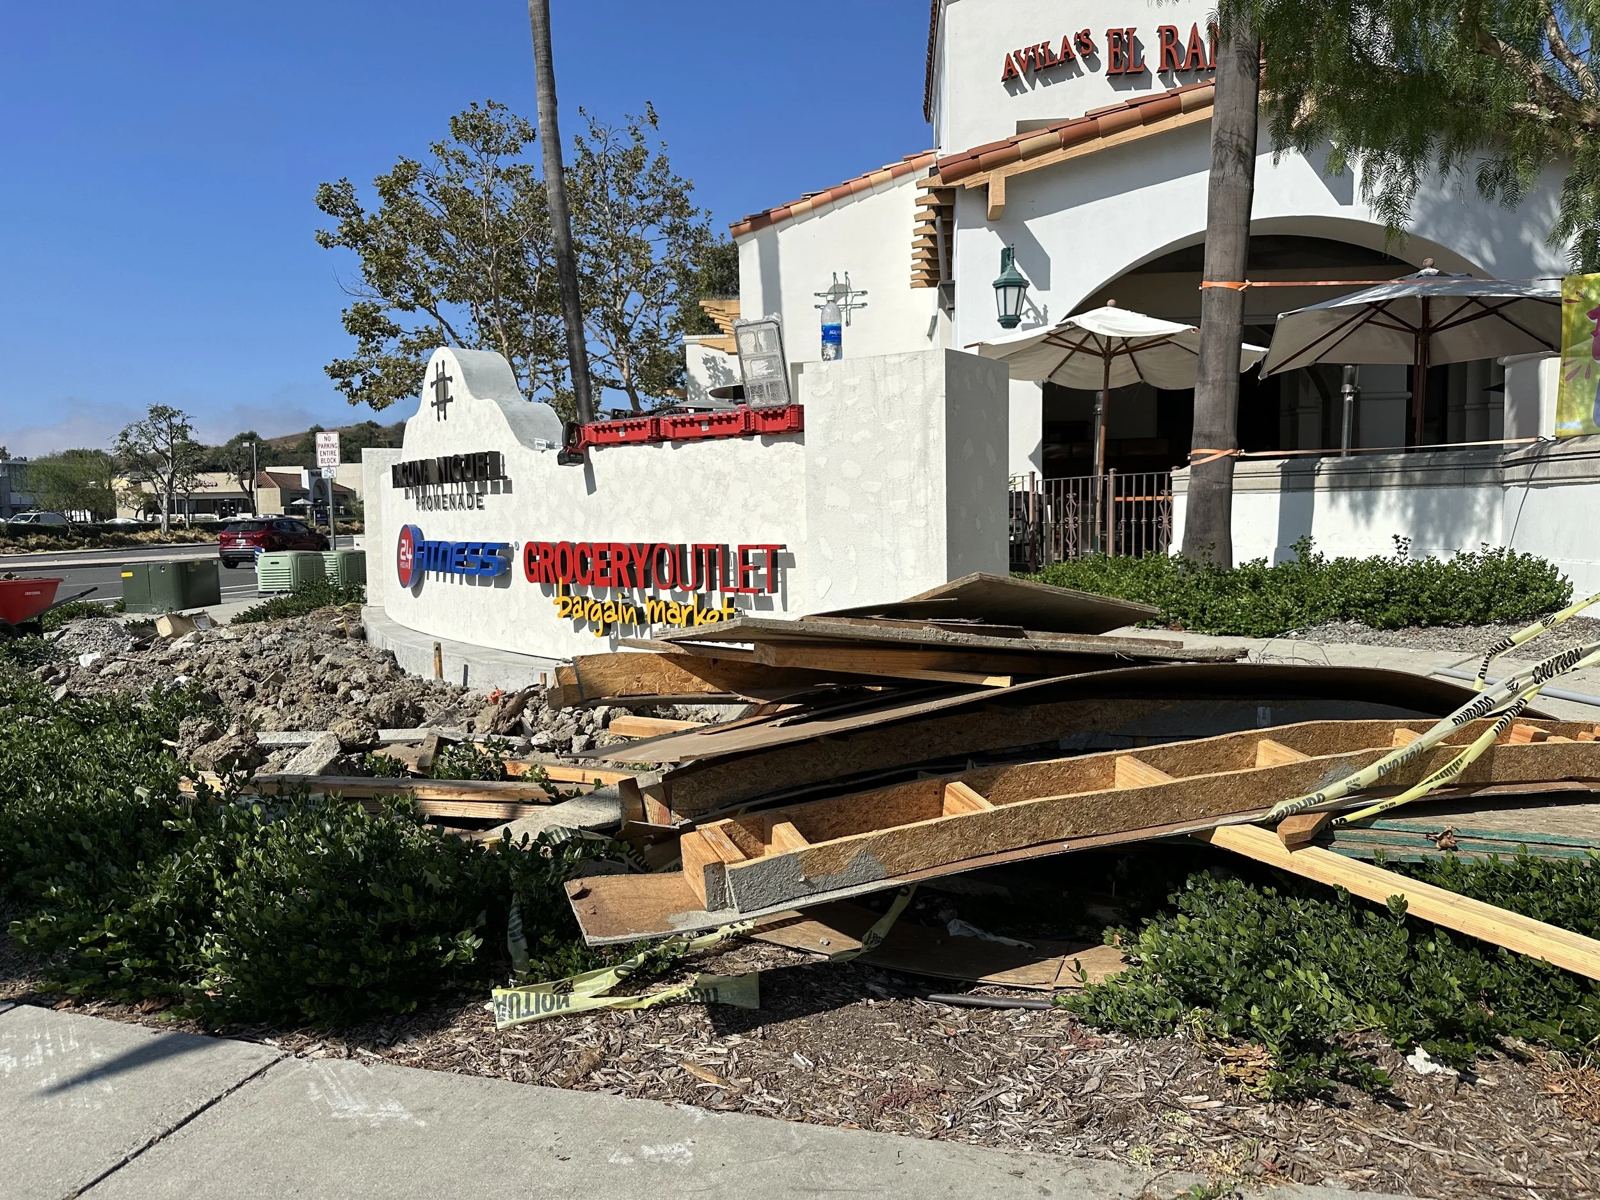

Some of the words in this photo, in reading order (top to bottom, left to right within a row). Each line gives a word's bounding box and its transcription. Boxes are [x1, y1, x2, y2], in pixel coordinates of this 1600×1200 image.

[1001, 28, 1093, 82] AVILA'S
[1105, 27, 1146, 76] EL
[415, 493, 485, 511] PROMENADE
[400, 538, 413, 570] 24
[414, 540, 509, 577] FITNESS
[553, 577, 639, 637] bargain
